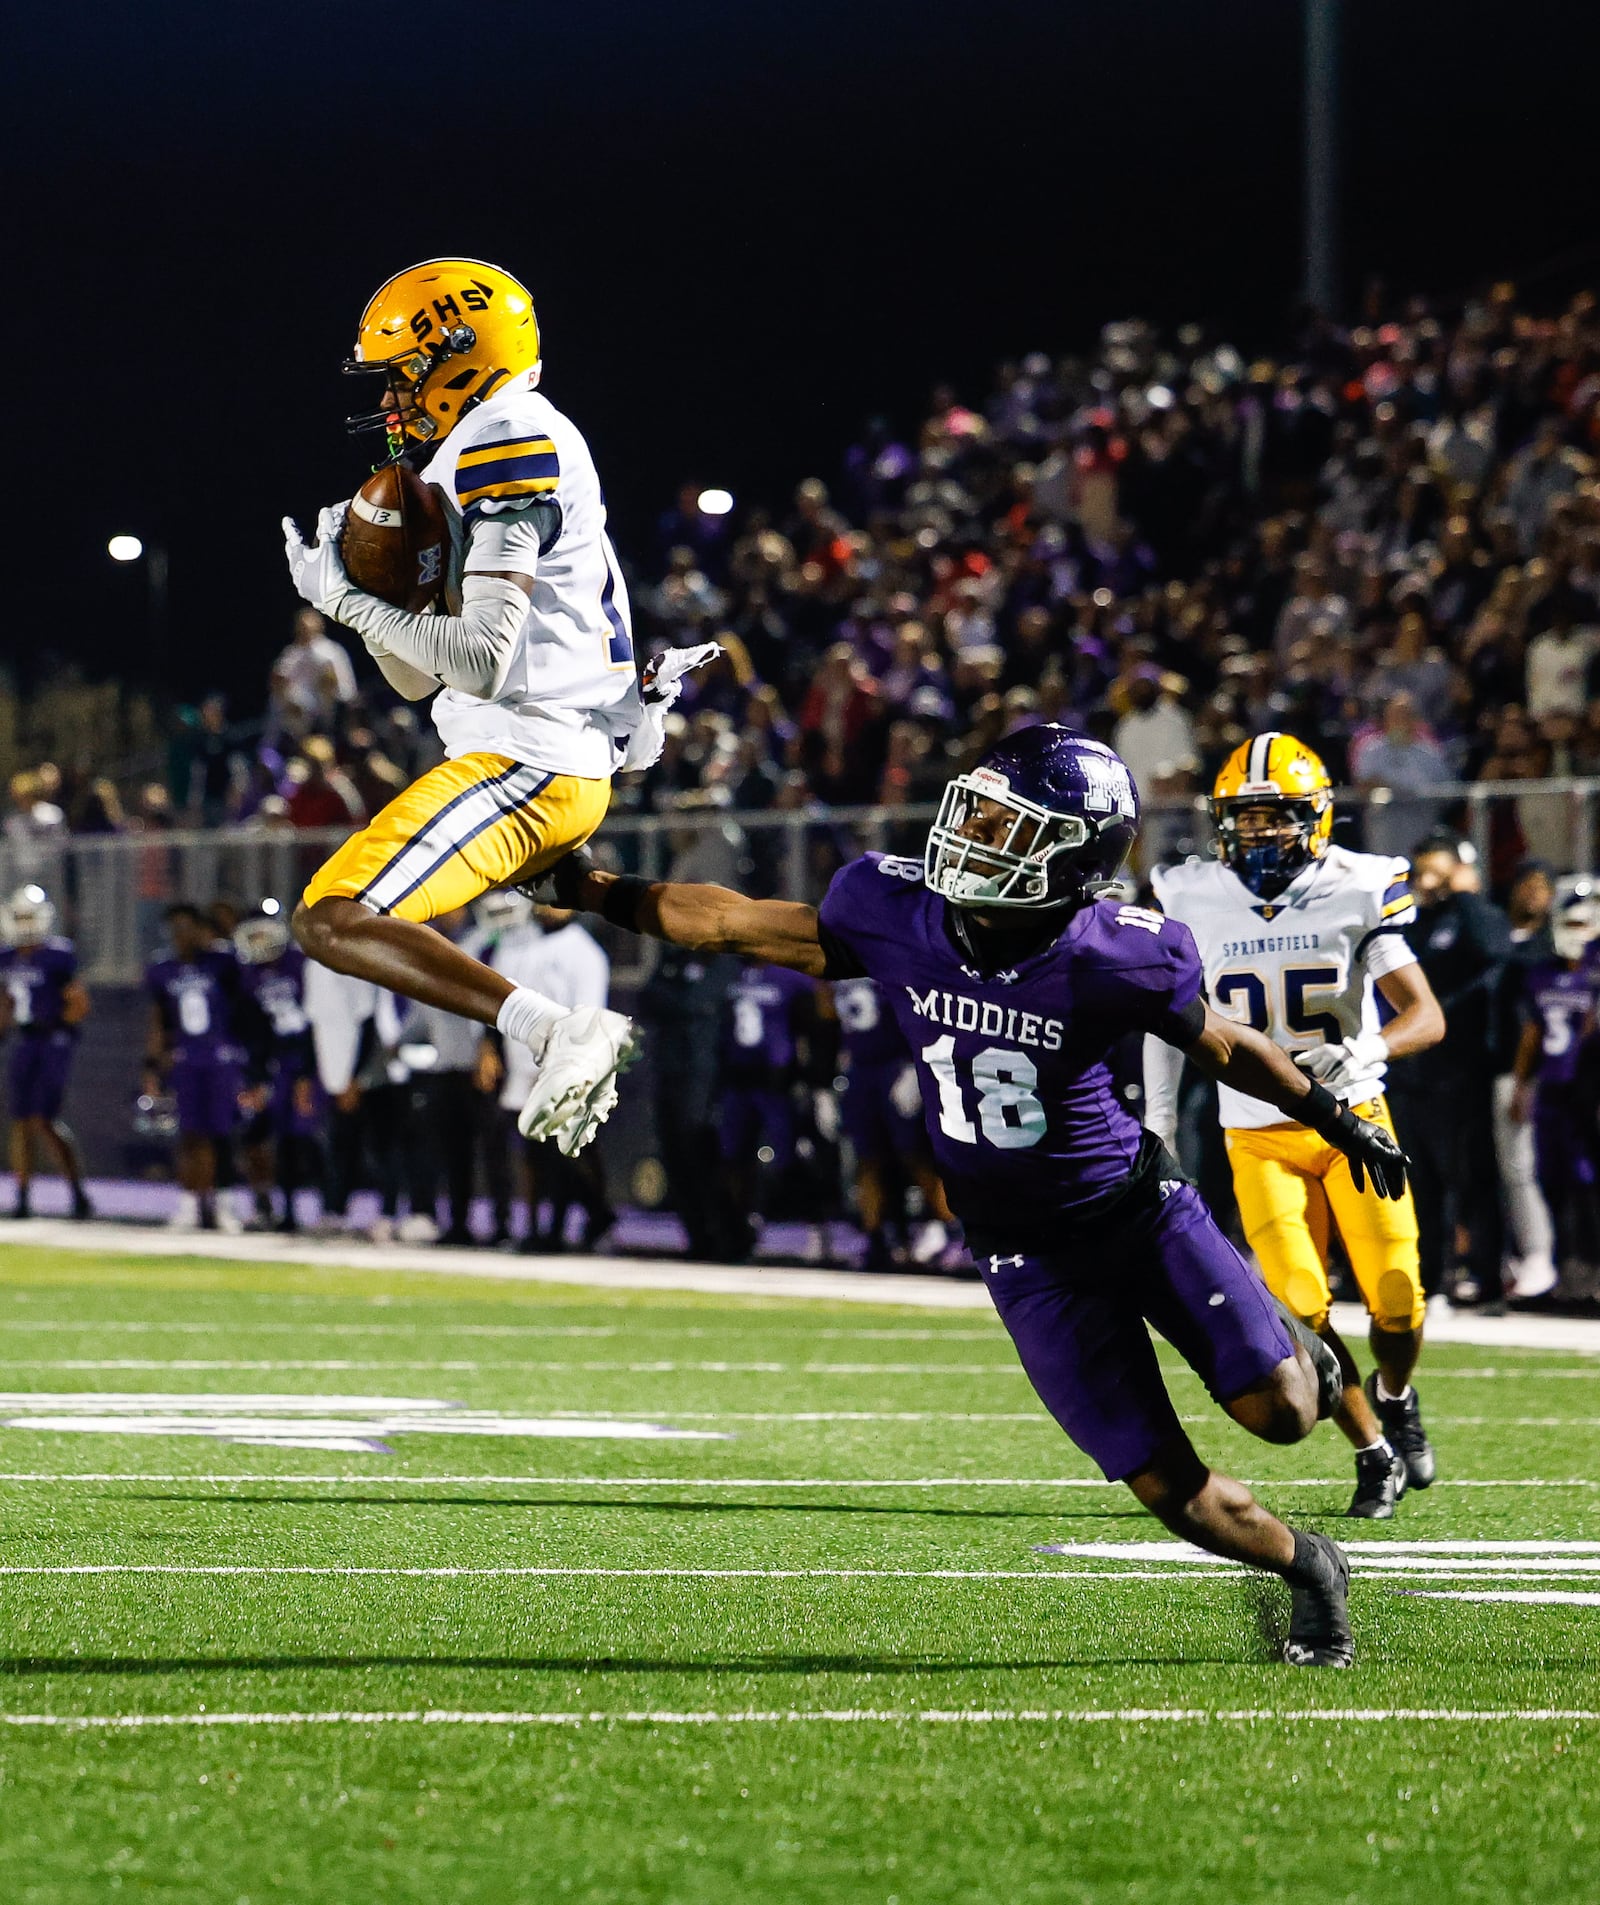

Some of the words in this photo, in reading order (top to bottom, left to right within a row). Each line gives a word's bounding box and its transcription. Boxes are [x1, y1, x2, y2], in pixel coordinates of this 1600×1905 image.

[410, 289, 489, 342] SHS
[372, 509, 391, 523] 13
[1223, 934, 1320, 957] SPRINGFIELD
[906, 986, 1064, 1050] MIDDIES
[1214, 962, 1343, 1057] 25
[921, 1034, 1048, 1149] 18
